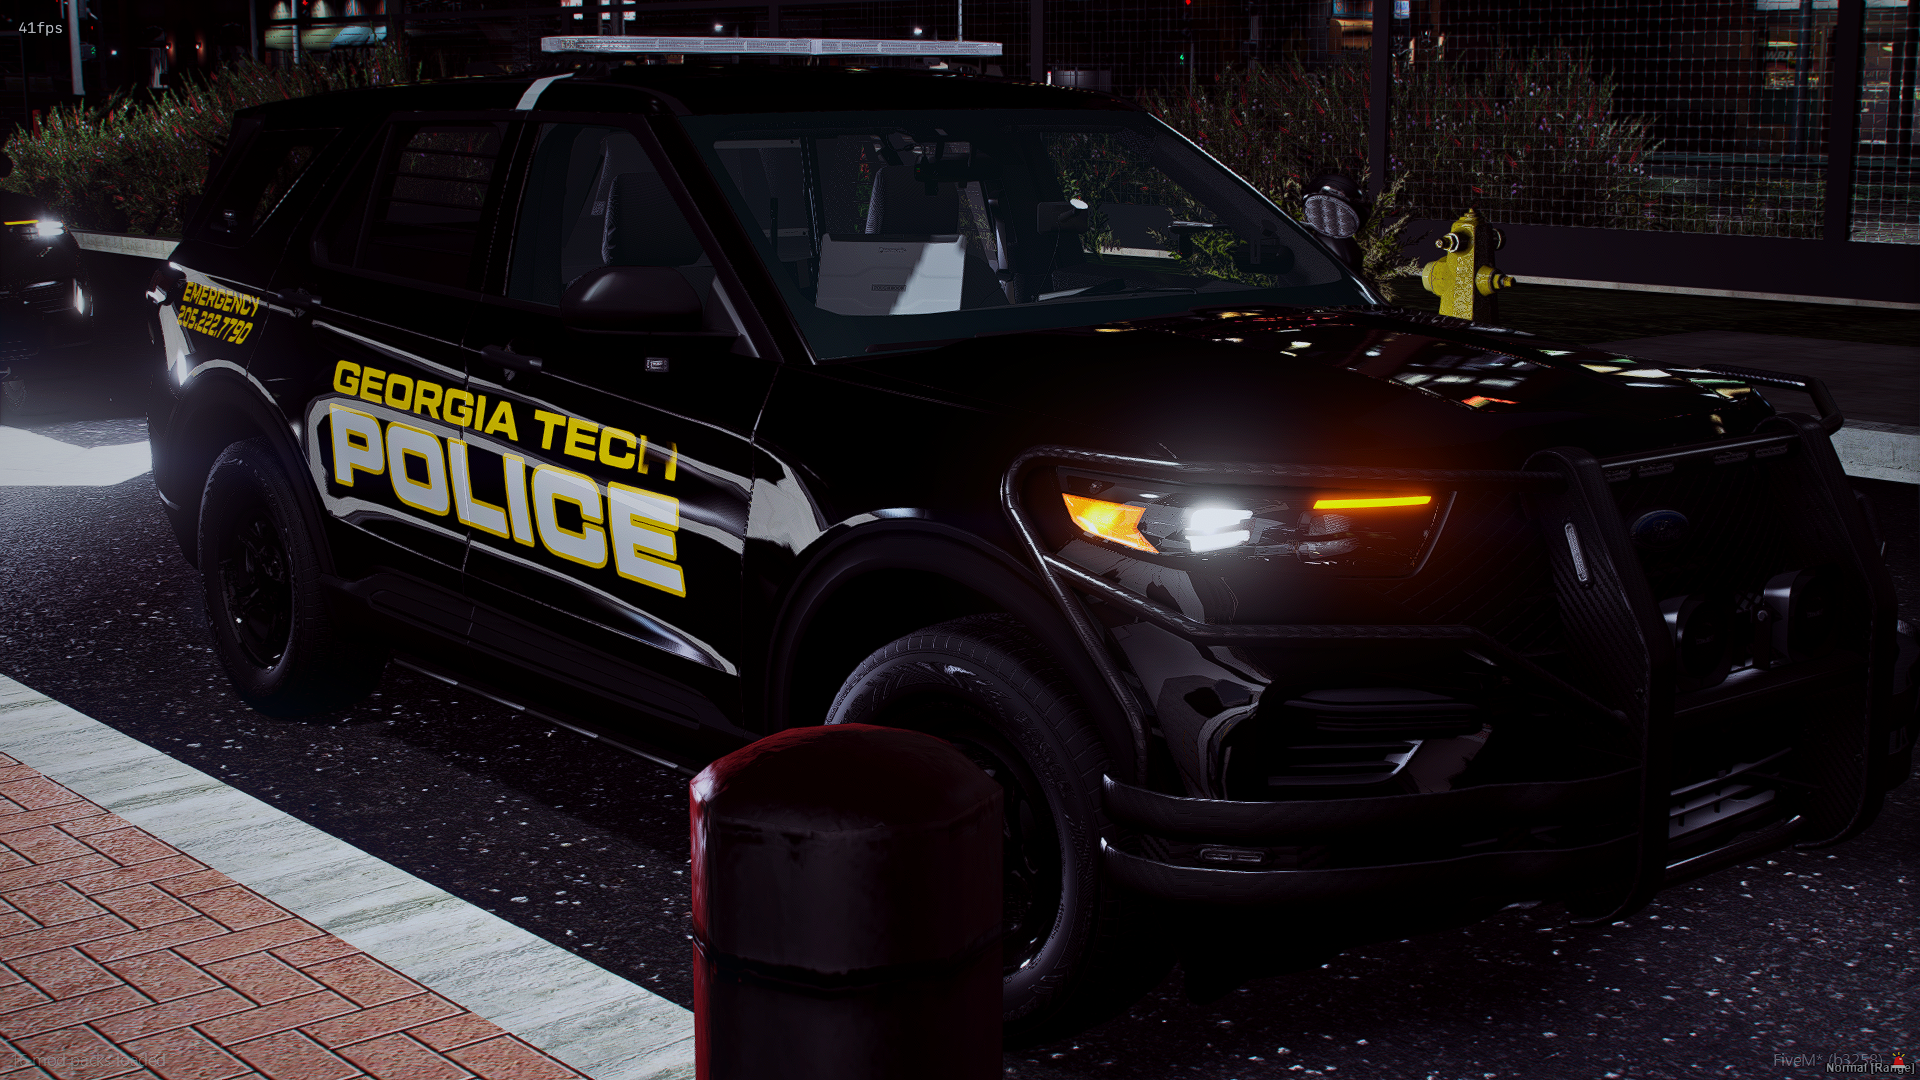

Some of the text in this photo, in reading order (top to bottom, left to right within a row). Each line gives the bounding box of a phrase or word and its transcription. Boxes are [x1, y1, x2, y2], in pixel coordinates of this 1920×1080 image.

[177, 304, 254, 345] 205.222.7790
[182, 281, 261, 318] EMERGENCY
[332, 359, 678, 482] GEORGIA TECH
[329, 402, 687, 599] POLICE
